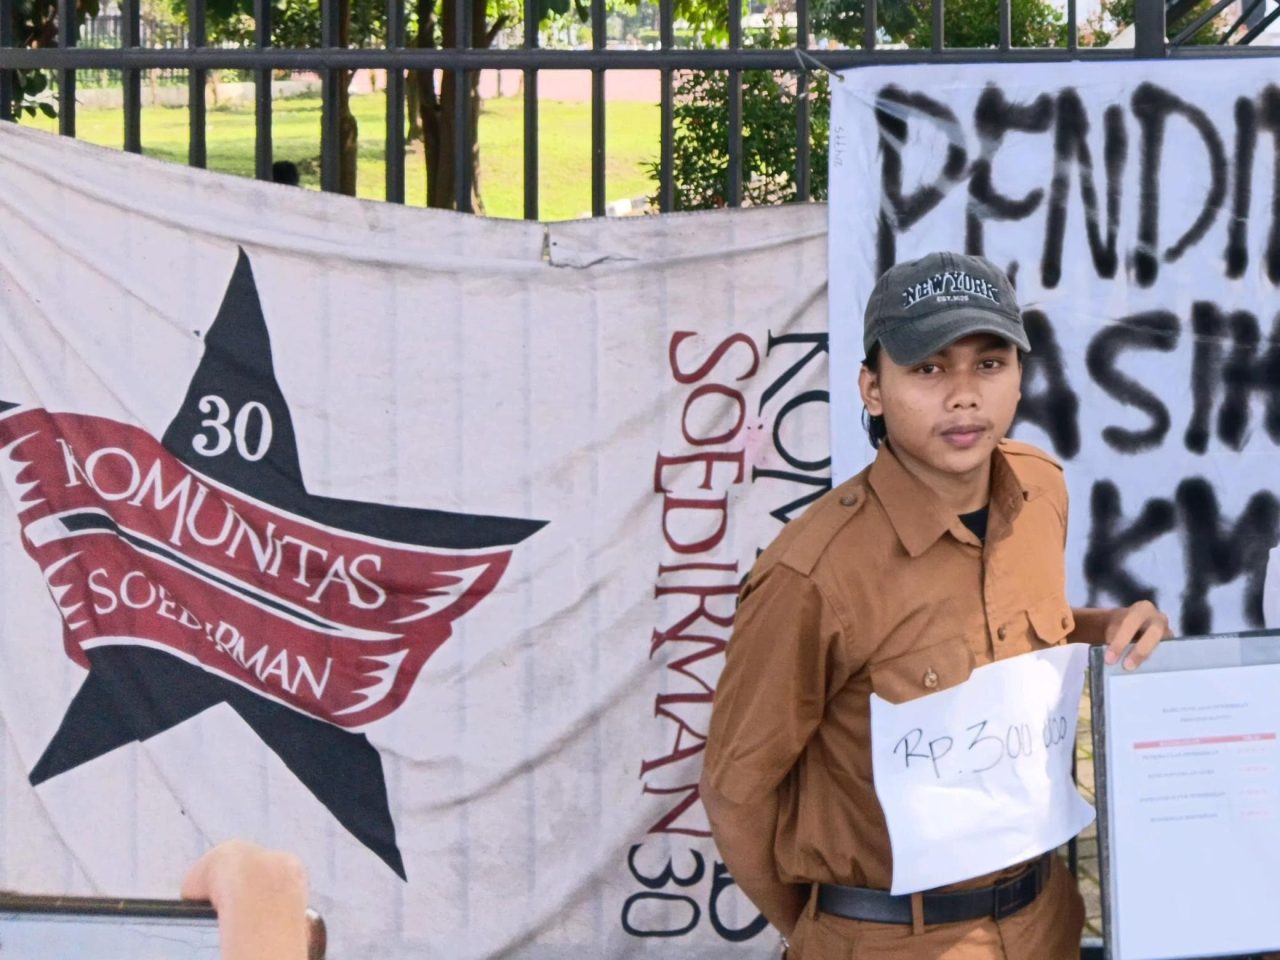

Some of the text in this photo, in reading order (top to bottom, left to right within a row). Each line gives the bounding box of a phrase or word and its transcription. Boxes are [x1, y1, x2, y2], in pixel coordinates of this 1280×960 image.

[902, 271, 1000, 309] NEW YORK
[192, 395, 273, 461] 30
[56, 438, 387, 610] KOMUNITAS
[88, 568, 334, 700] SOEDRMAN
[621, 330, 760, 937] SOEDIRMAN 30
